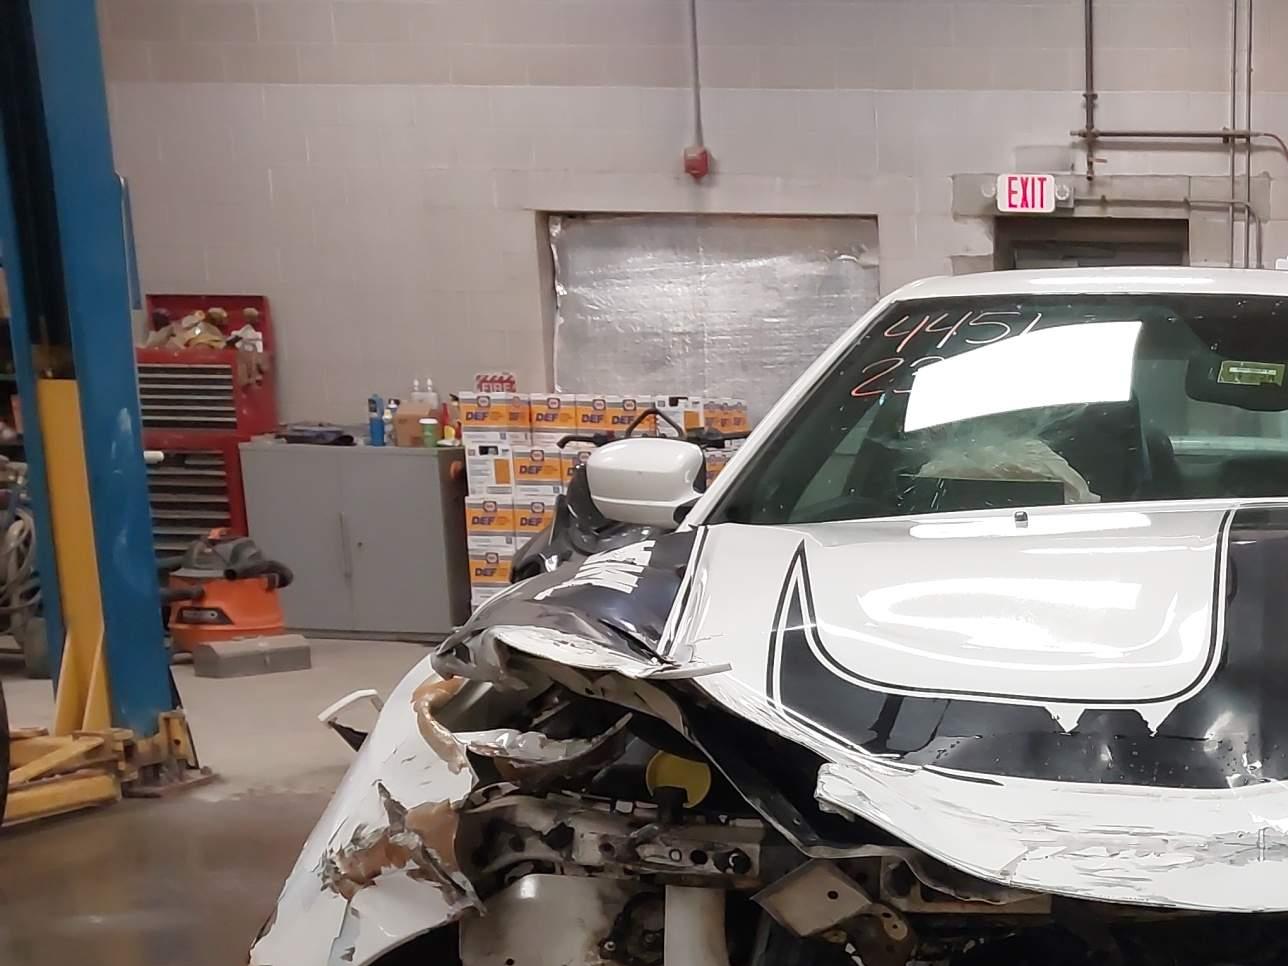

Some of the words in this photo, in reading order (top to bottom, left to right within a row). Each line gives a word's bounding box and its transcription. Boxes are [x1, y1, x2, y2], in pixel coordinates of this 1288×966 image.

[1008, 176, 1047, 208] EXIT
[884, 311, 1042, 353] 4451
[481, 382, 513, 393] FIRE
[465, 411, 489, 422] DEF
[535, 412, 559, 422] DEF
[581, 413, 605, 424] DEF
[611, 414, 635, 425] DEF
[519, 465, 544, 475] DEF
[471, 516, 496, 526] DEF
[519, 517, 543, 527] DEF
[474, 567, 497, 577] DEF
